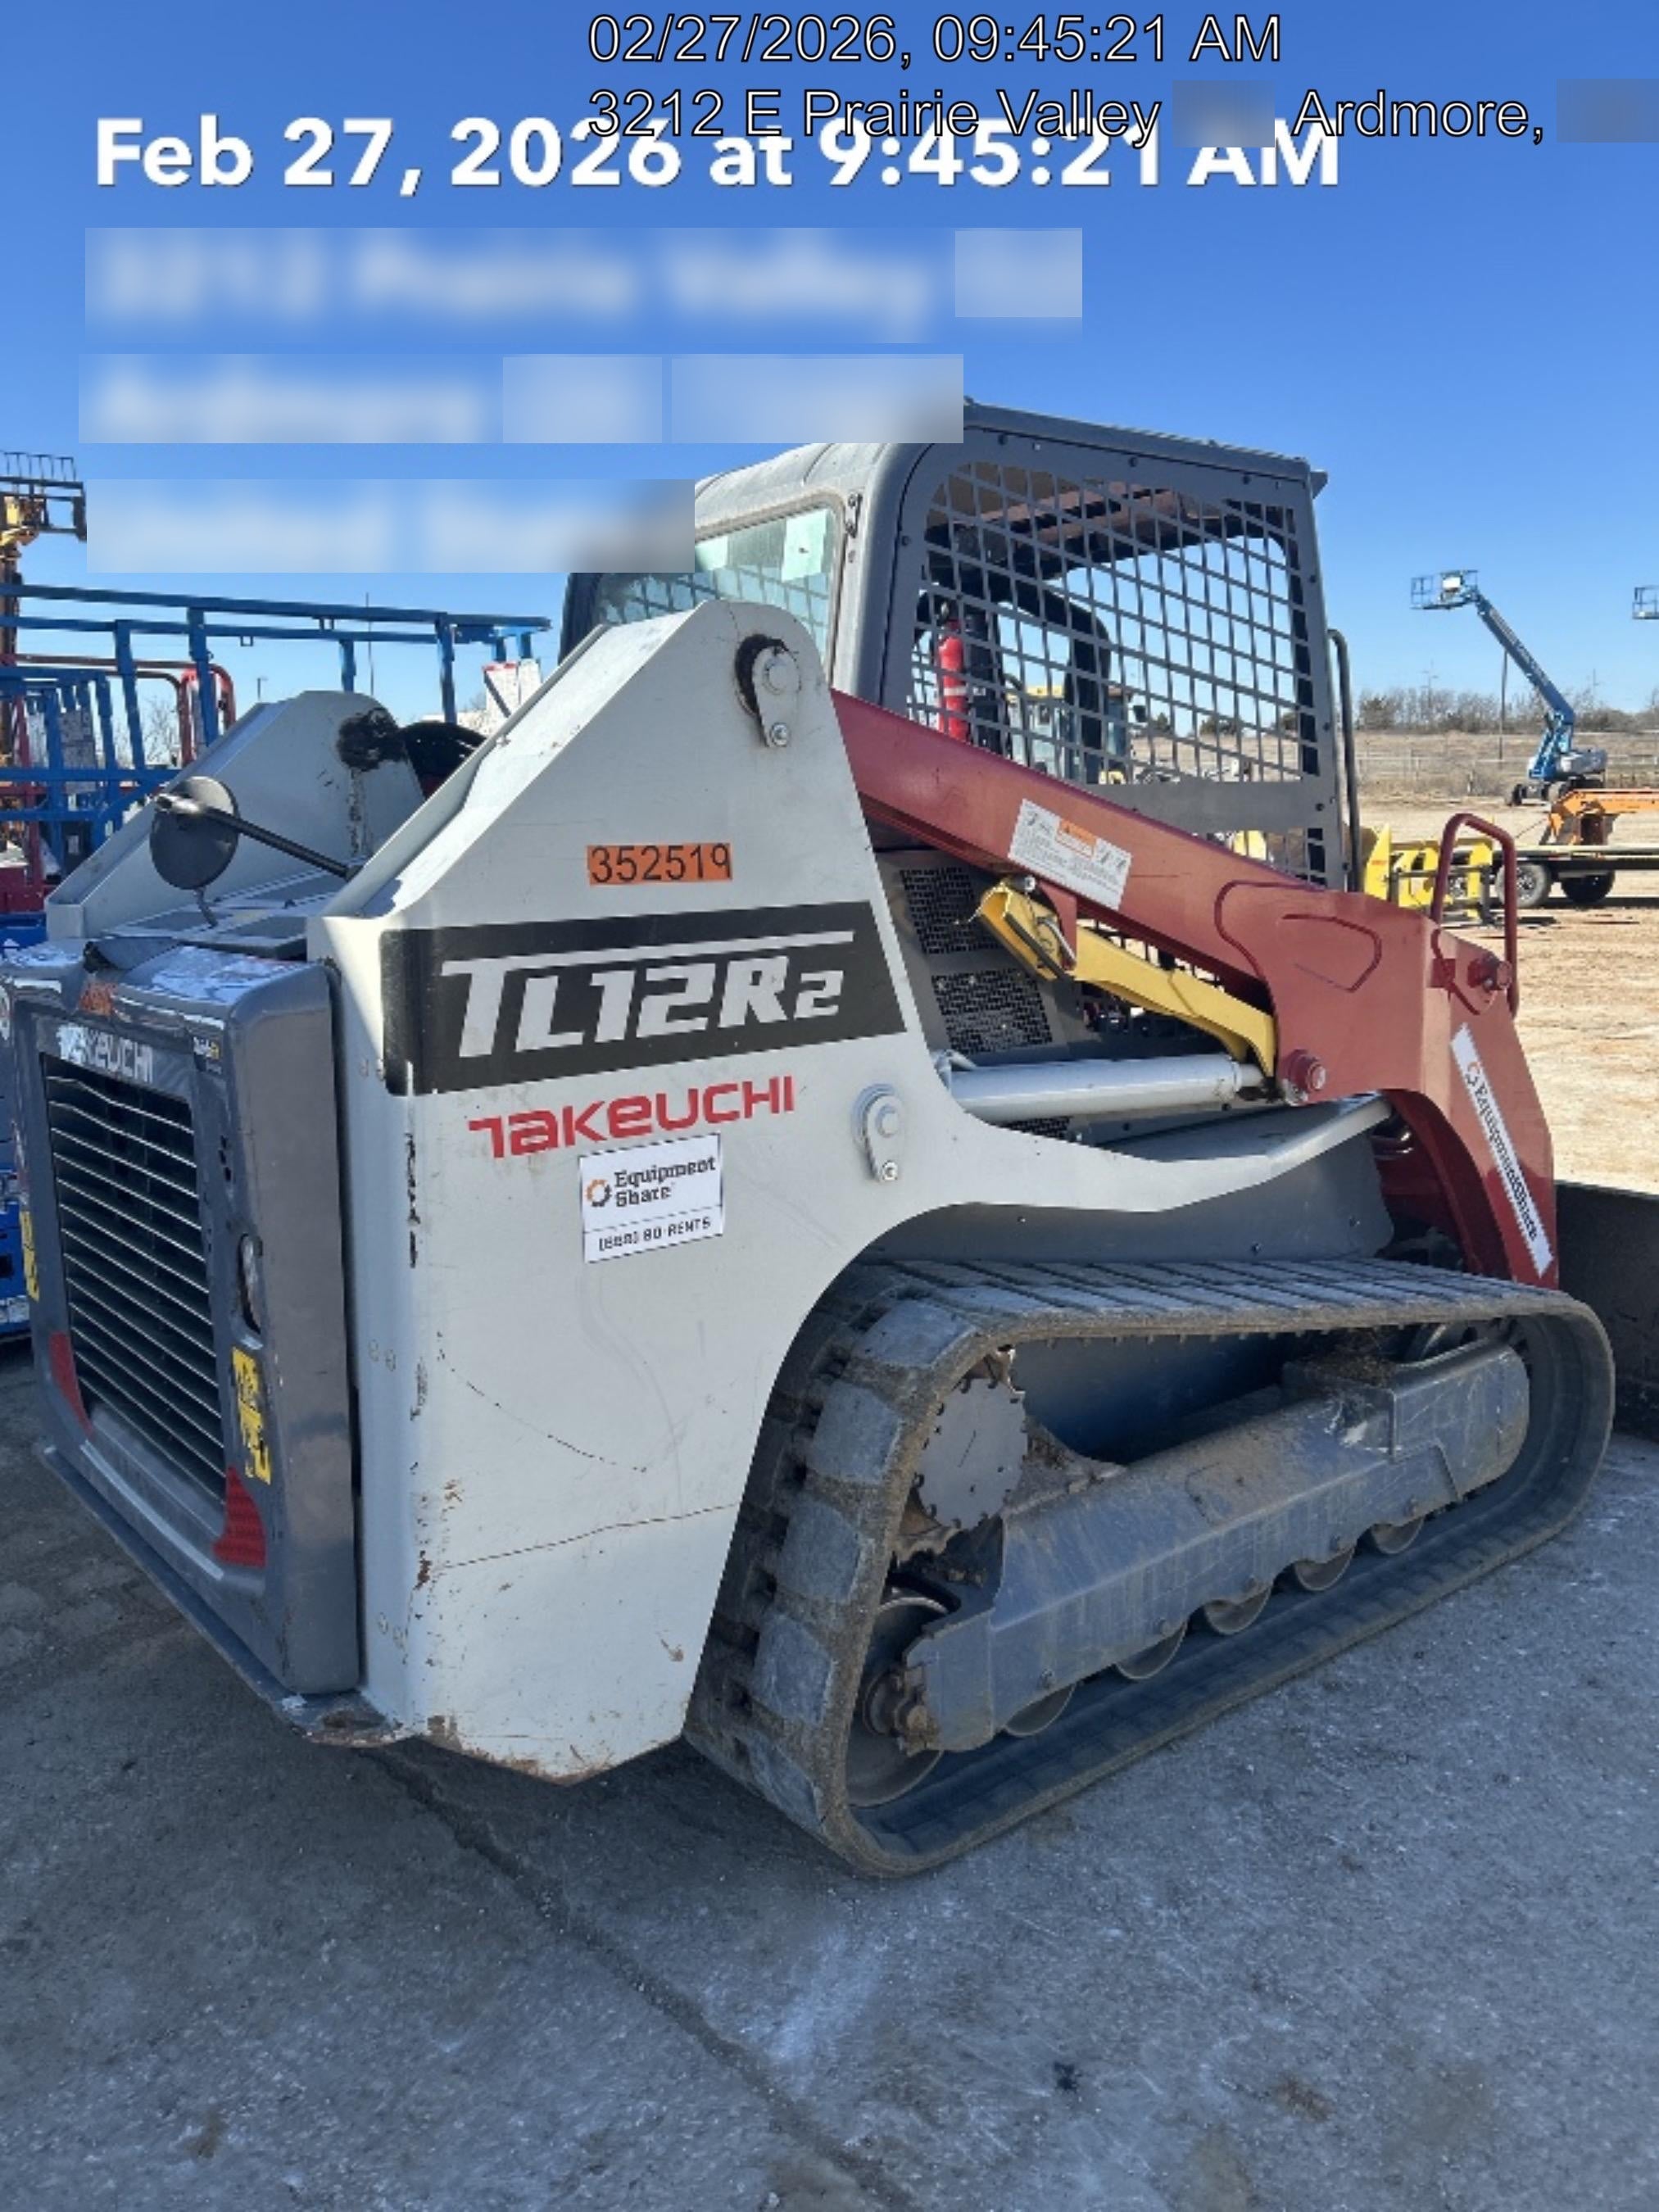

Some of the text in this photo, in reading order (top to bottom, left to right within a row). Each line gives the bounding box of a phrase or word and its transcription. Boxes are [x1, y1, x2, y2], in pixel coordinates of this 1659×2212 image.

[591, 844, 732, 882] 352519
[469, 1076, 794, 1158] TAKEUCHI
[614, 1156, 716, 1187] Equipment
